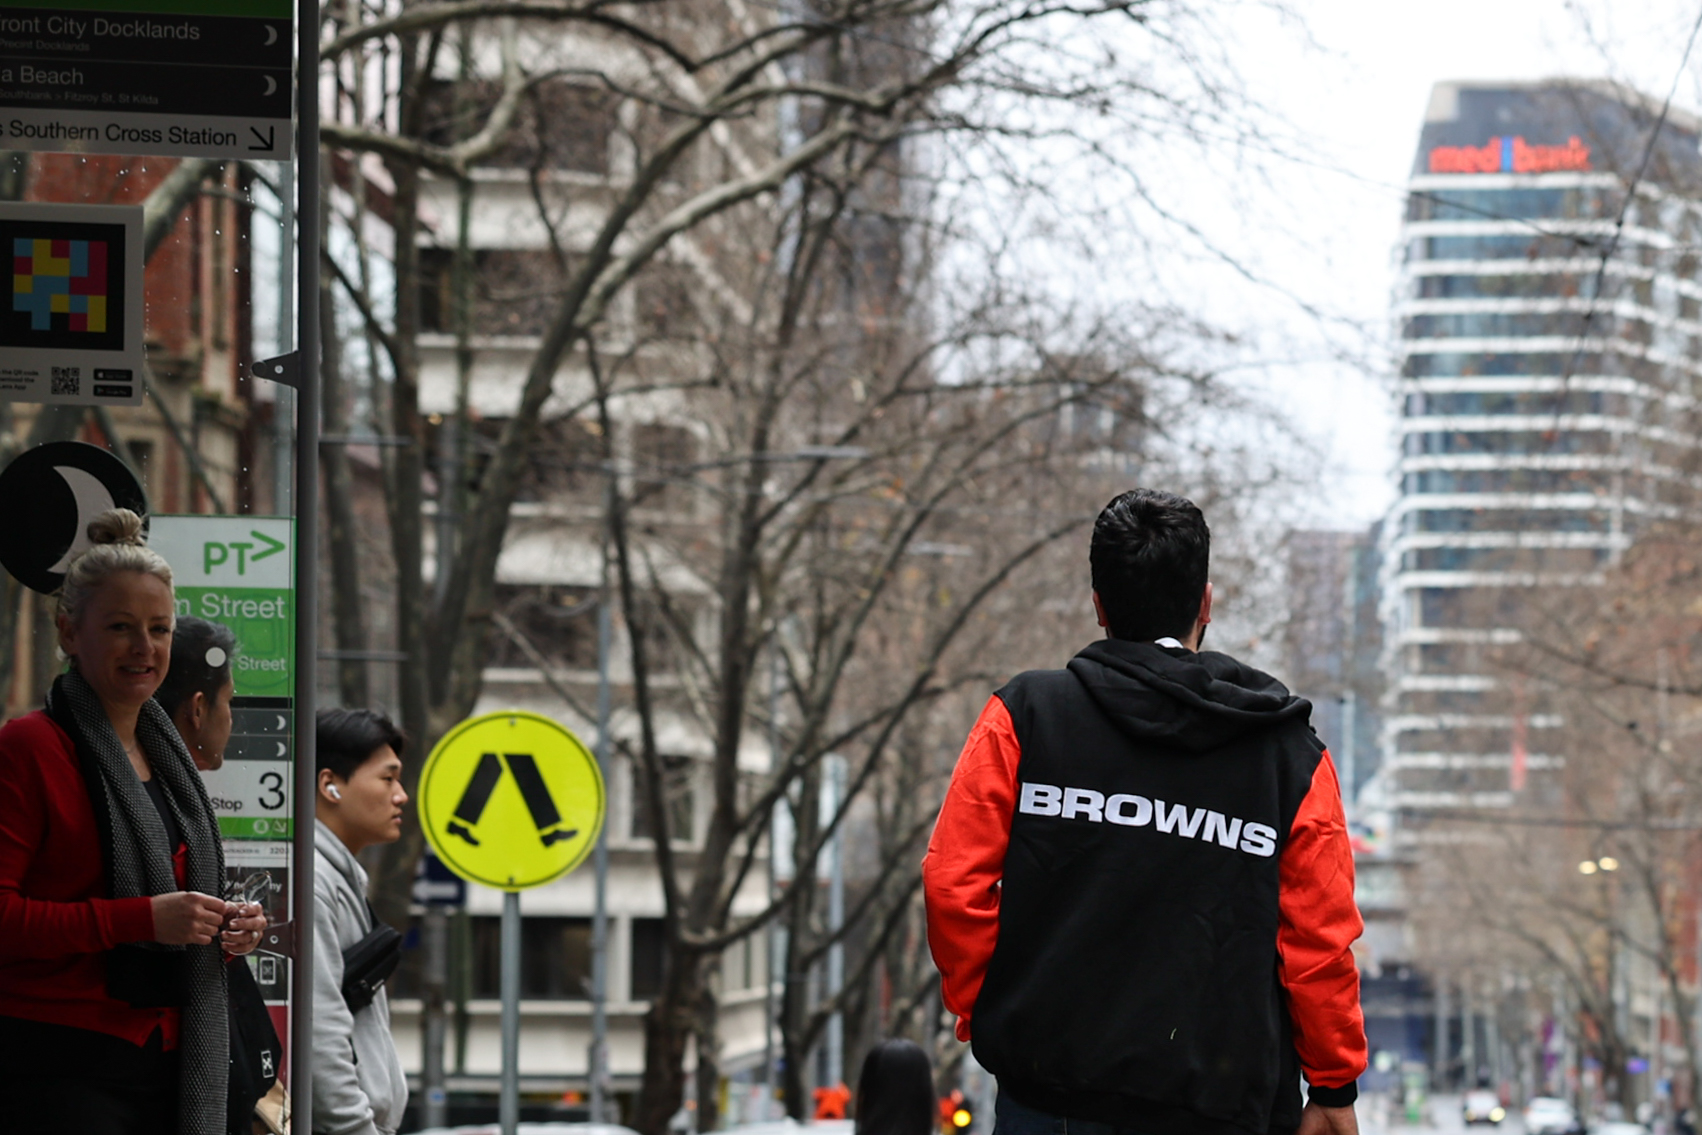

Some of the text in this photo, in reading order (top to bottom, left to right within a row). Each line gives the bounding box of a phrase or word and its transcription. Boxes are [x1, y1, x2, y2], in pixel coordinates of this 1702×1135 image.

[0, 15, 201, 40] ront City Docklands
[36, 40, 91, 52] Docklands
[20, 65, 84, 85] Beach
[64, 92, 99, 104] Fitzroy
[118, 93, 130, 103] St
[132, 94, 159, 105] Kilda
[9, 120, 99, 141] Southern
[105, 124, 162, 143] Cross
[168, 127, 237, 146] Station
[201, 593, 286, 619] Street
[238, 656, 287, 671] Street
[258, 772, 285, 810] 3
[211, 797, 243, 812] Stop
[1018, 781, 1278, 858] BROWNS
